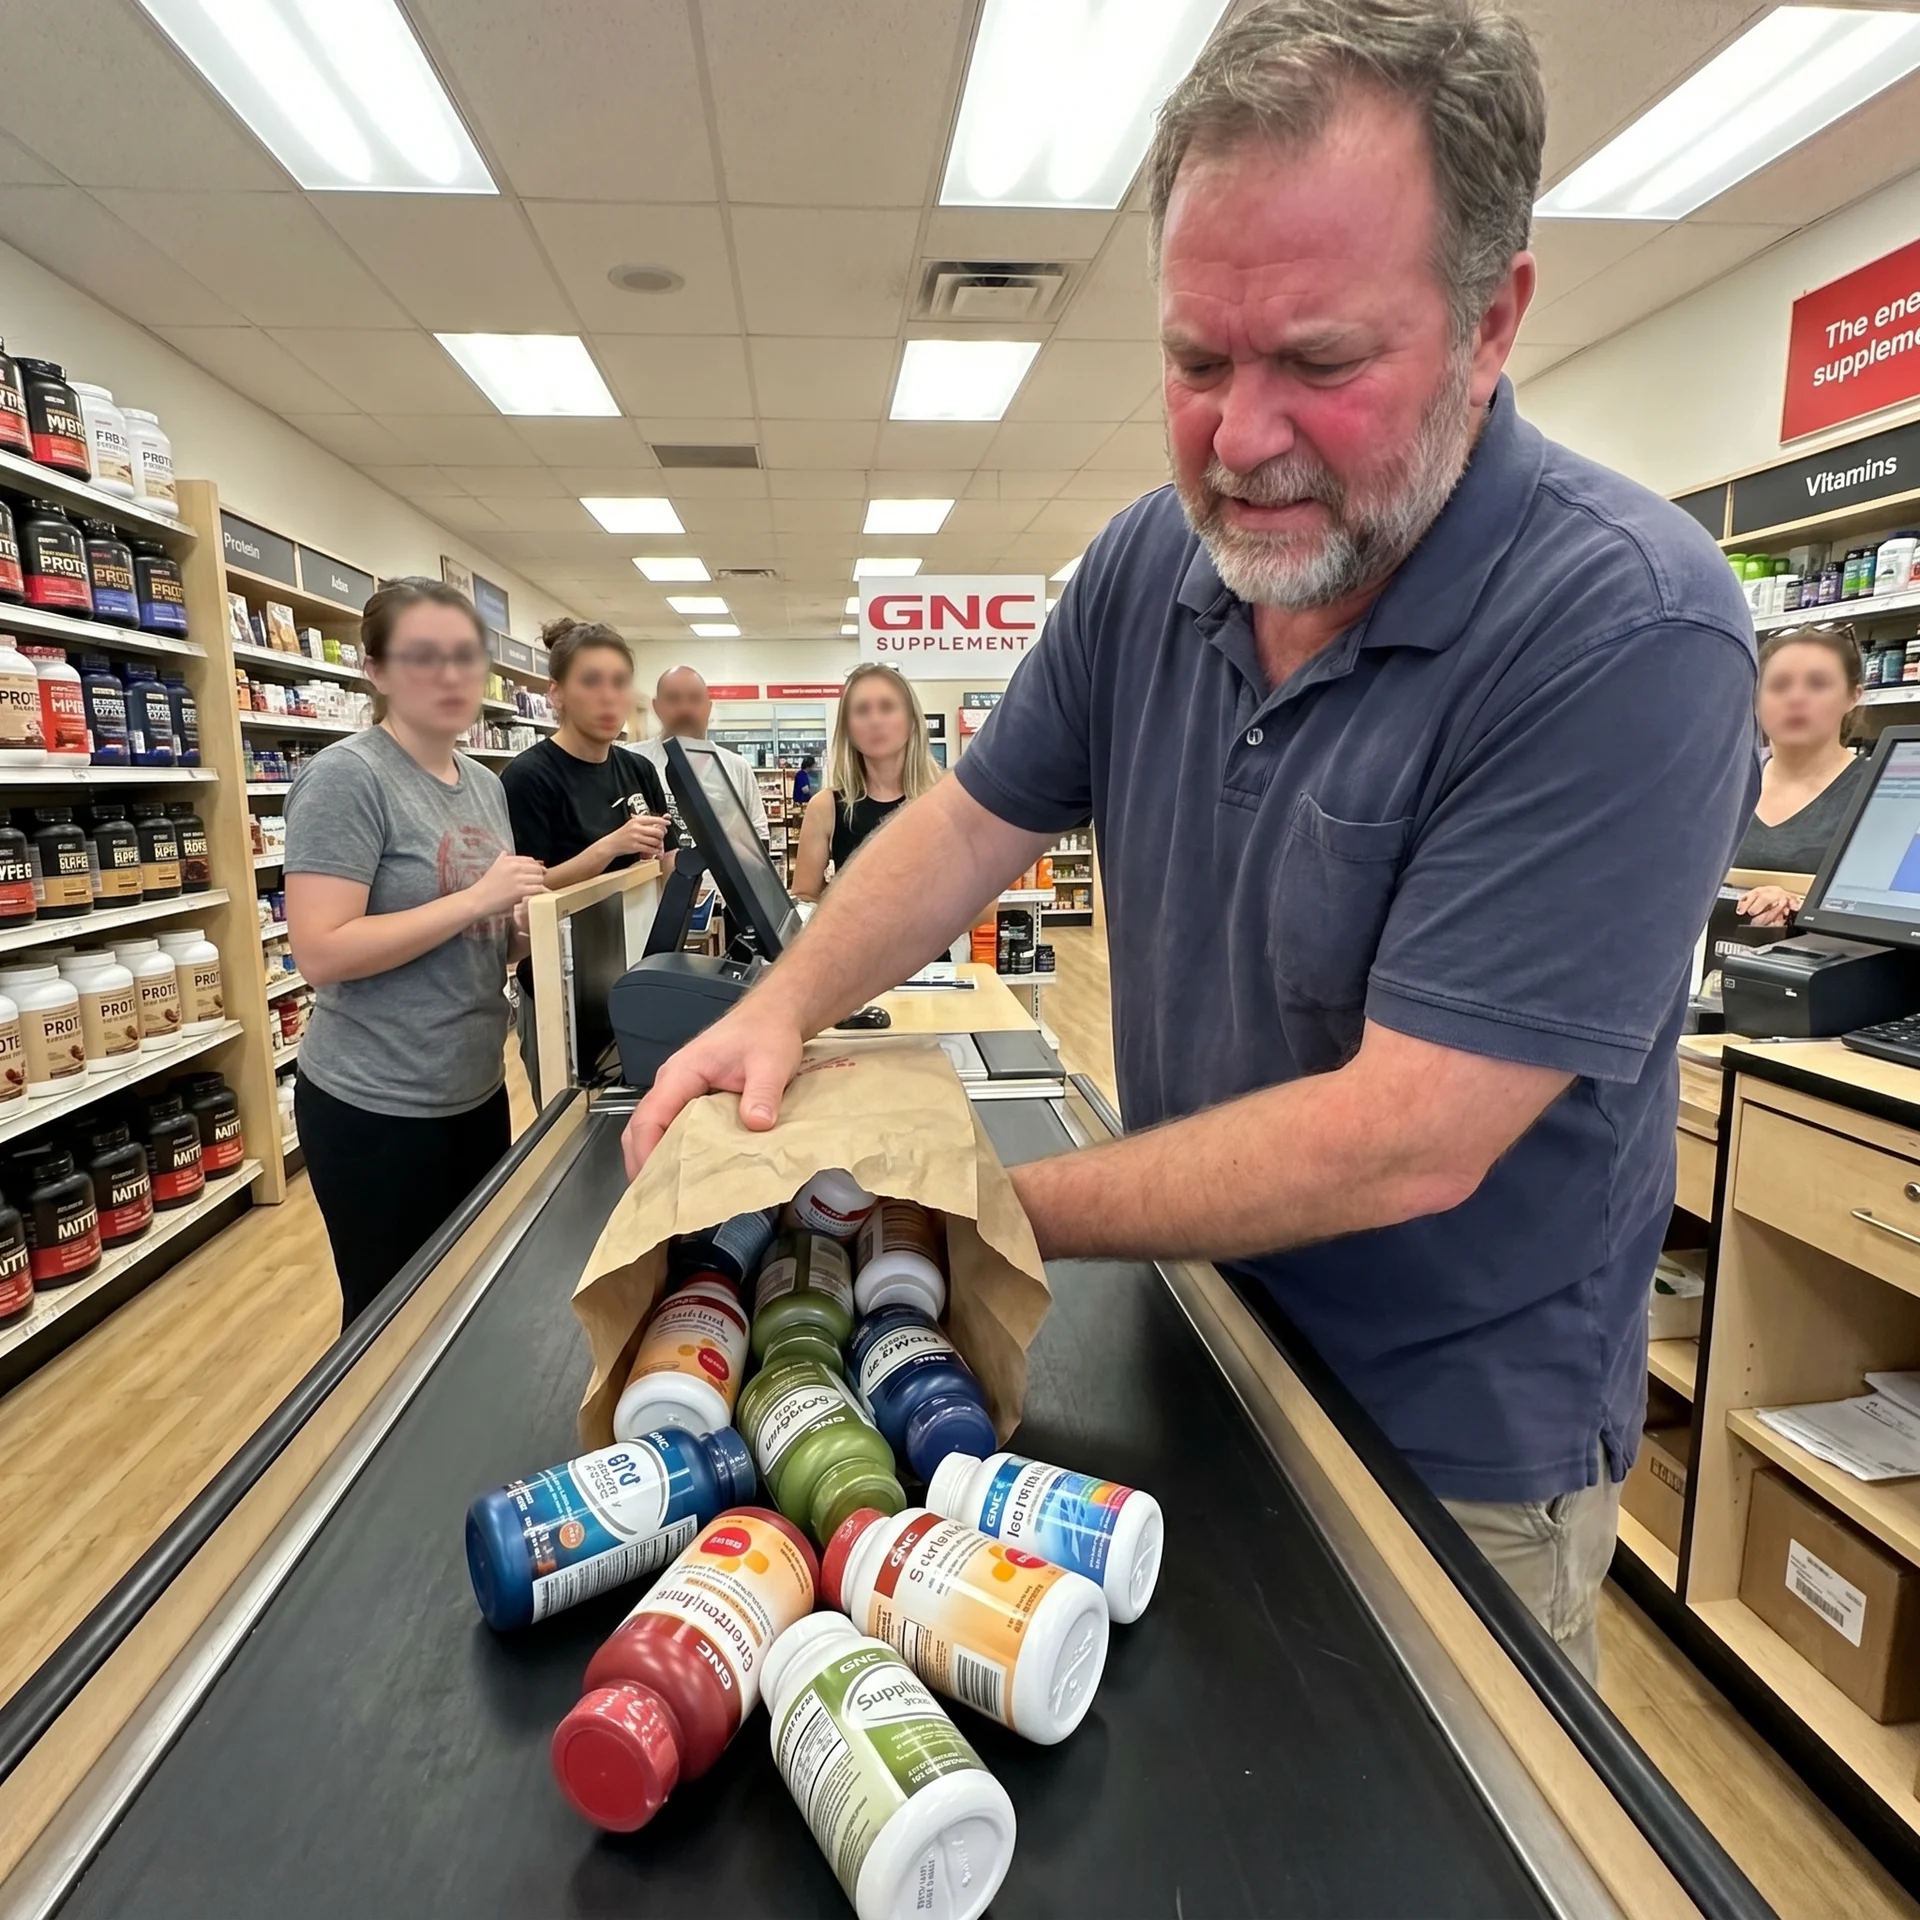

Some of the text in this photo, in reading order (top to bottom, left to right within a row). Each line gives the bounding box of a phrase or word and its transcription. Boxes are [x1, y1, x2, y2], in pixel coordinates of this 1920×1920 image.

[1826, 316, 1868, 349] The
[1806, 457, 1897, 497] Vitamins
[223, 532, 260, 560] Protein
[868, 595, 1035, 631] GNC
[877, 637, 1029, 651] SUPPLEMENT
[986, 1491, 1004, 1528] GNC
[891, 1532, 918, 1568] GNC
[696, 1640, 732, 1690] GNC
[839, 1653, 880, 1674] GNC
